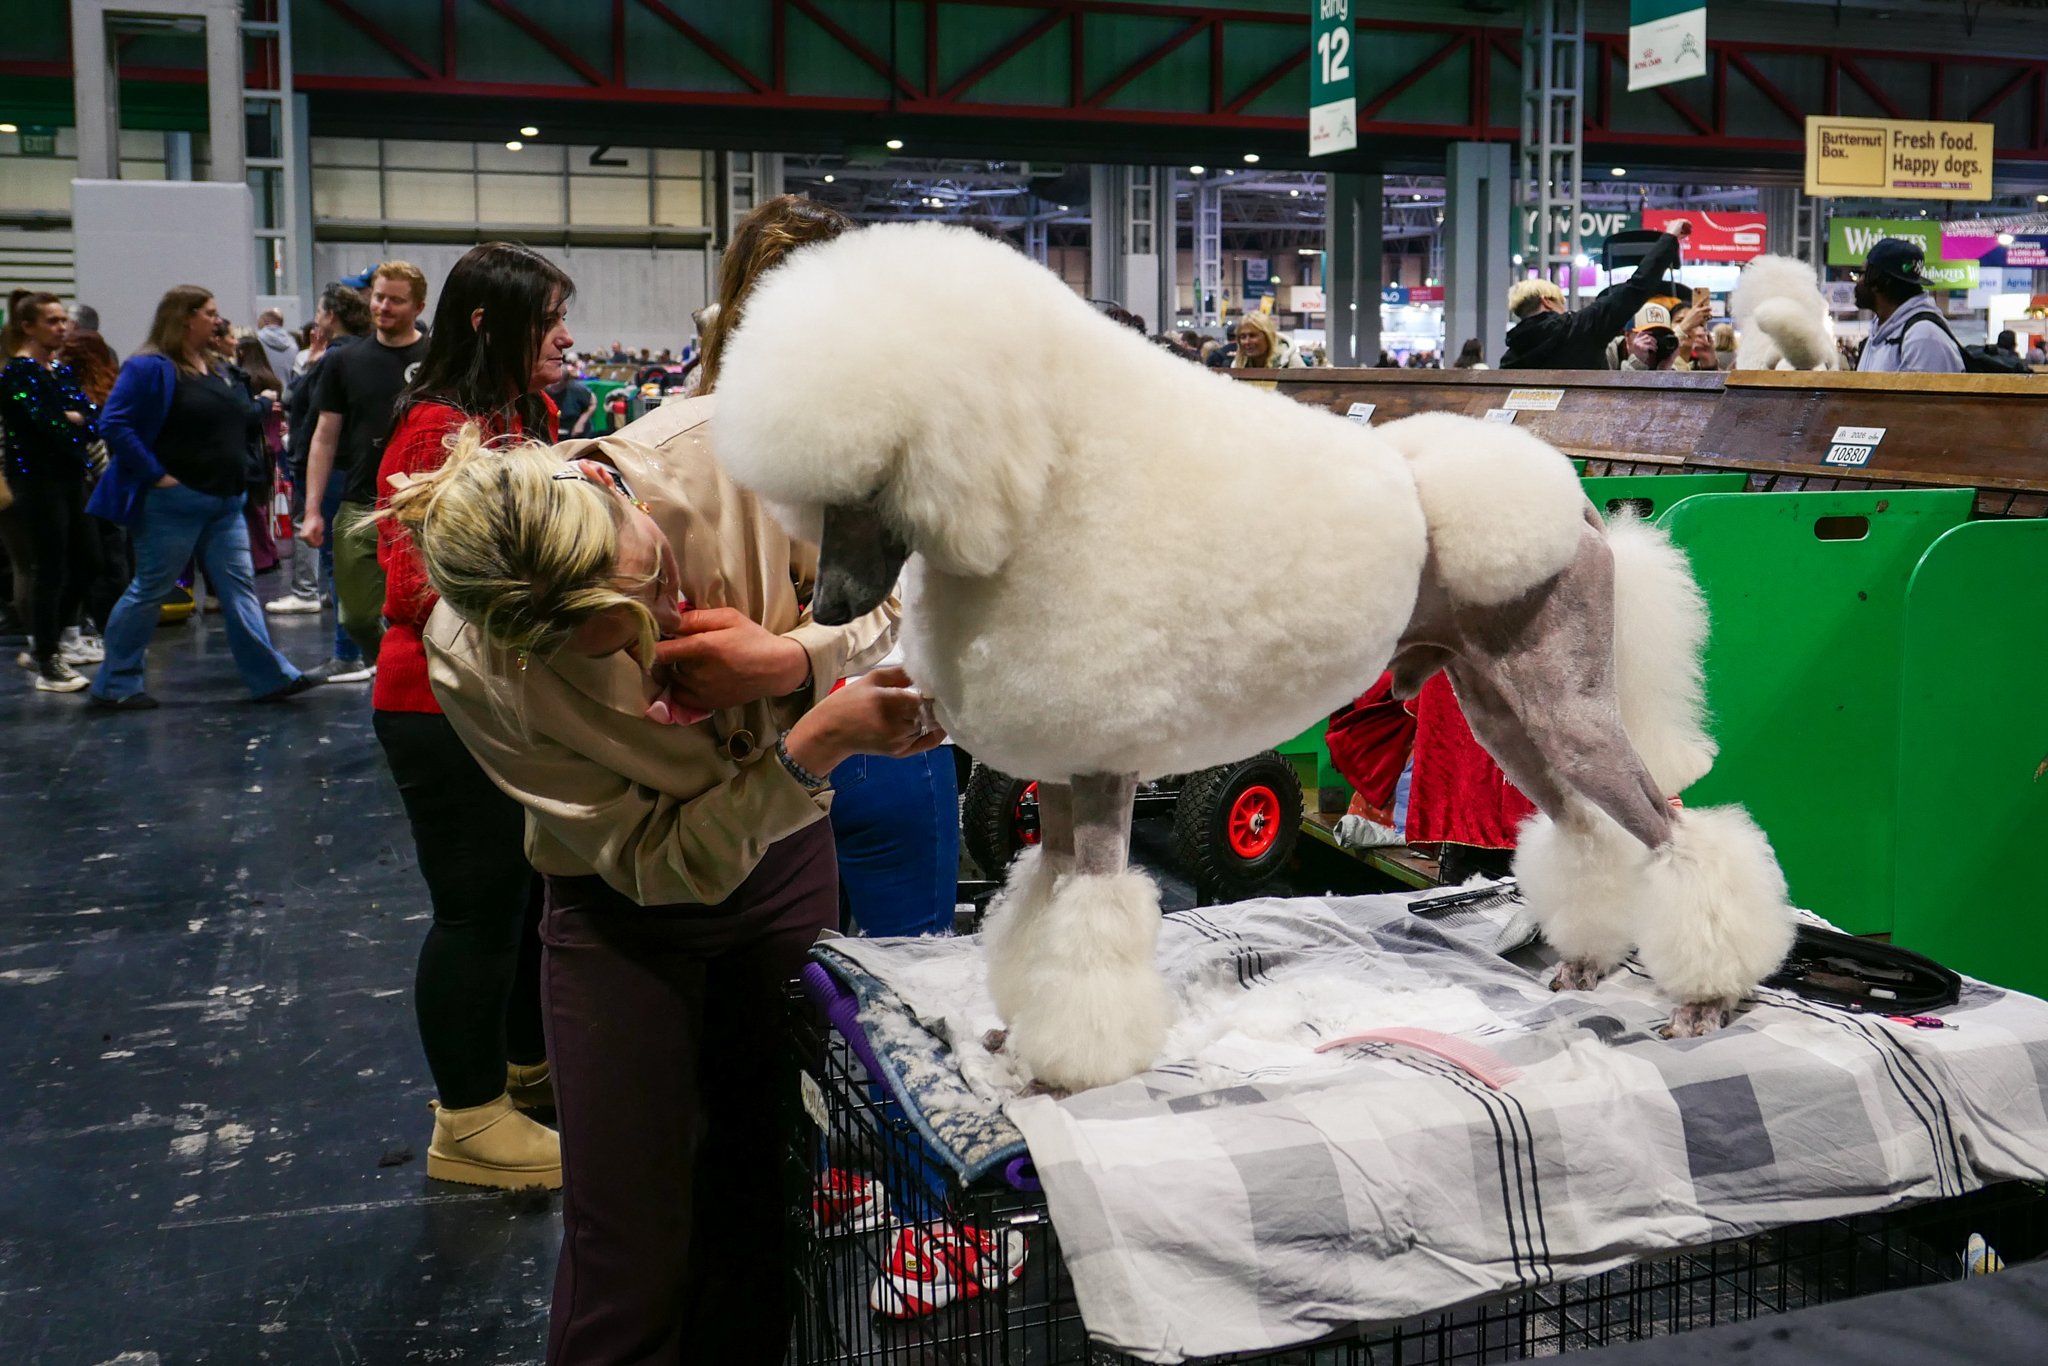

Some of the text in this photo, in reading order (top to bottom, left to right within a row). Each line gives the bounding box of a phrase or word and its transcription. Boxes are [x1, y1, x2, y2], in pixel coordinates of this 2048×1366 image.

[1318, 26, 1350, 85] 12
[1822, 132, 1882, 146] Butternut
[1893, 131, 1977, 151] Fresh food.
[1822, 145, 1849, 158] Box.
[1893, 154, 1983, 178] Happy dogs.
[1832, 447, 1866, 462] 10880
